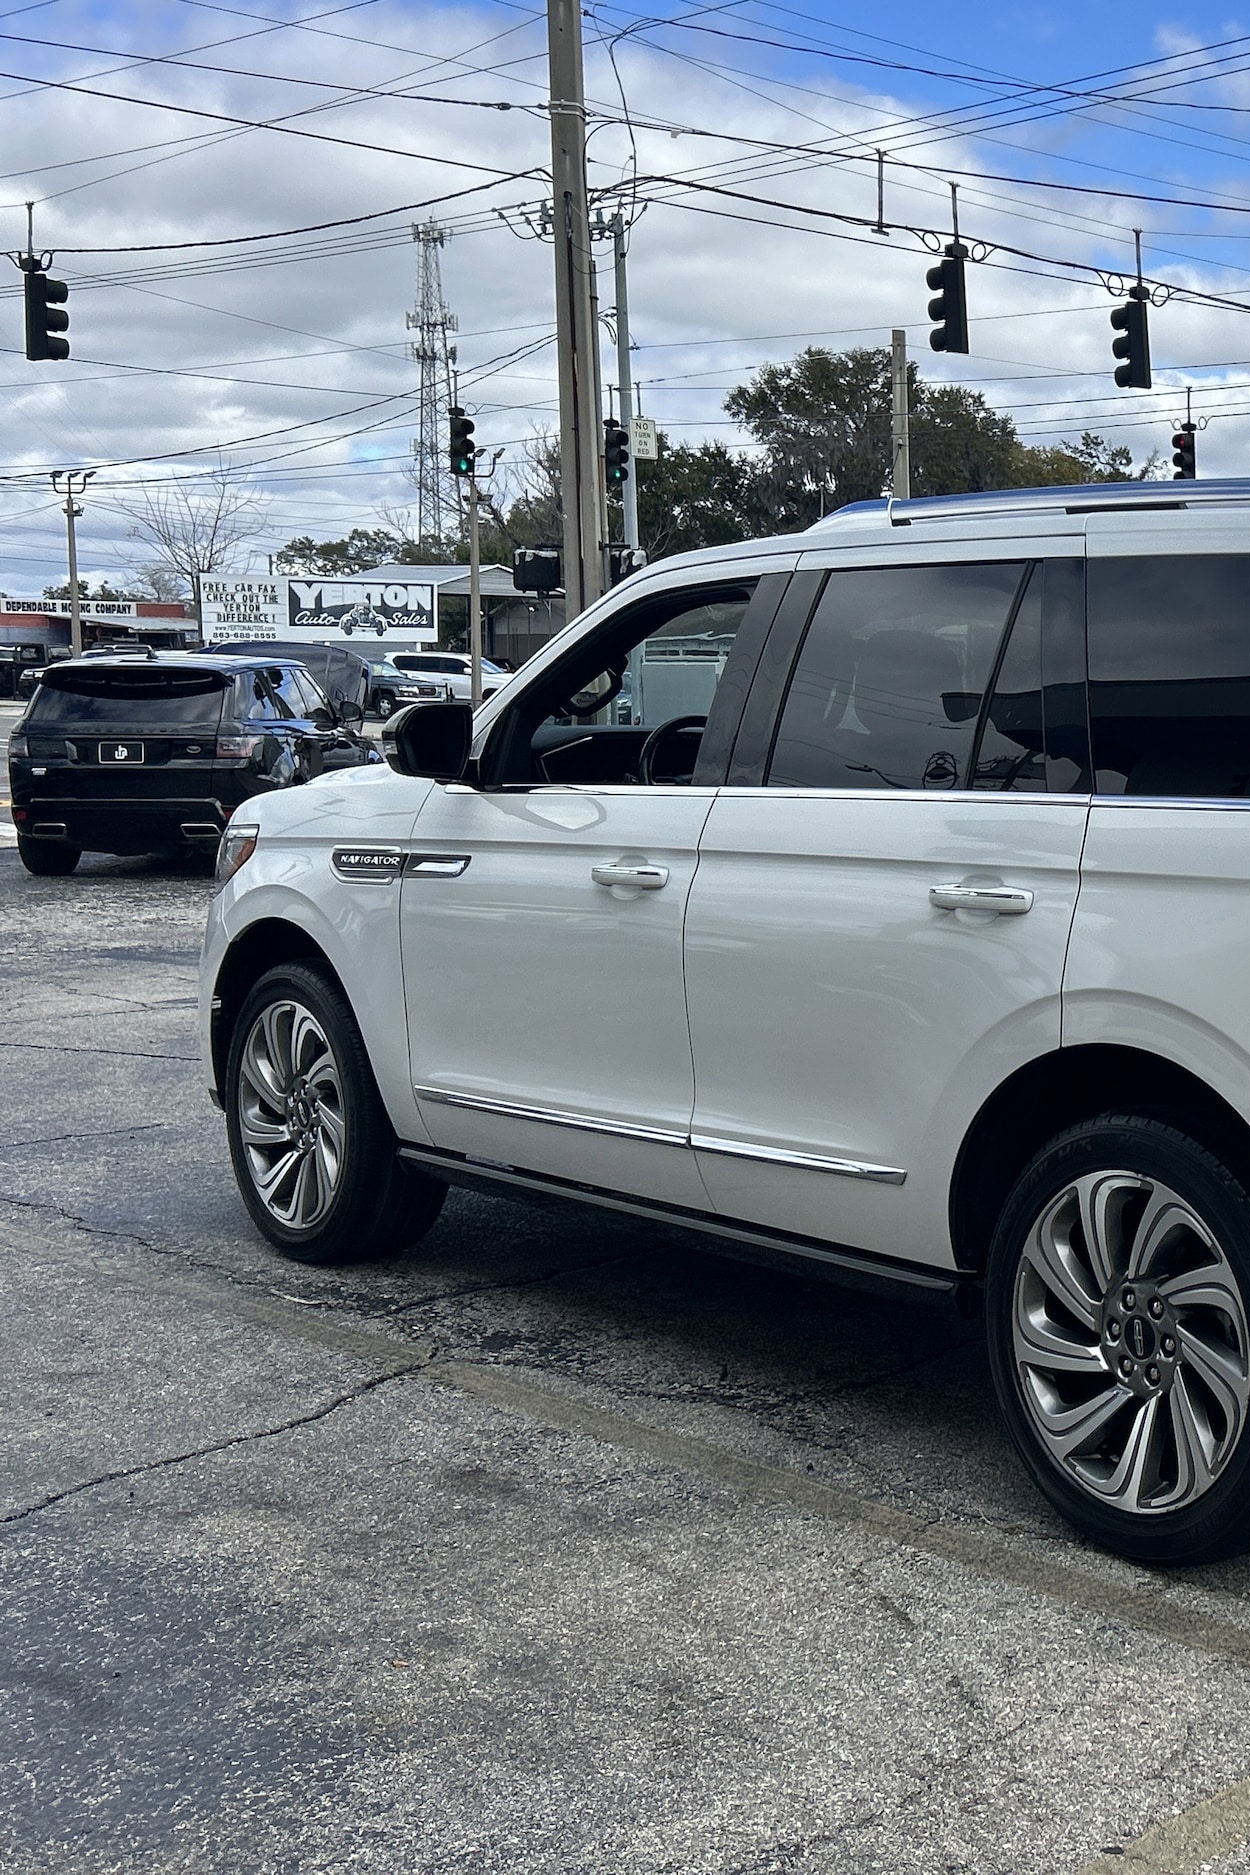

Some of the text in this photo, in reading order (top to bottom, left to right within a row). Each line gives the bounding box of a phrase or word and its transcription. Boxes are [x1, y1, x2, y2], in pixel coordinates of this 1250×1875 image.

[635, 422, 649, 430] NO
[634, 431, 651, 439] TURN
[202, 583, 276, 593] FREE CAR FAX
[206, 593, 279, 604] CHECK OUT THE
[289, 581, 432, 611] YERTON
[5, 601, 132, 614] DEPENDABLE MONG COMPANY
[223, 603, 261, 612] YERTON
[217, 613, 269, 623] DIFFERENCE
[294, 611, 428, 625] Auto Sales
[340, 855, 400, 865] NAVIGATOR
